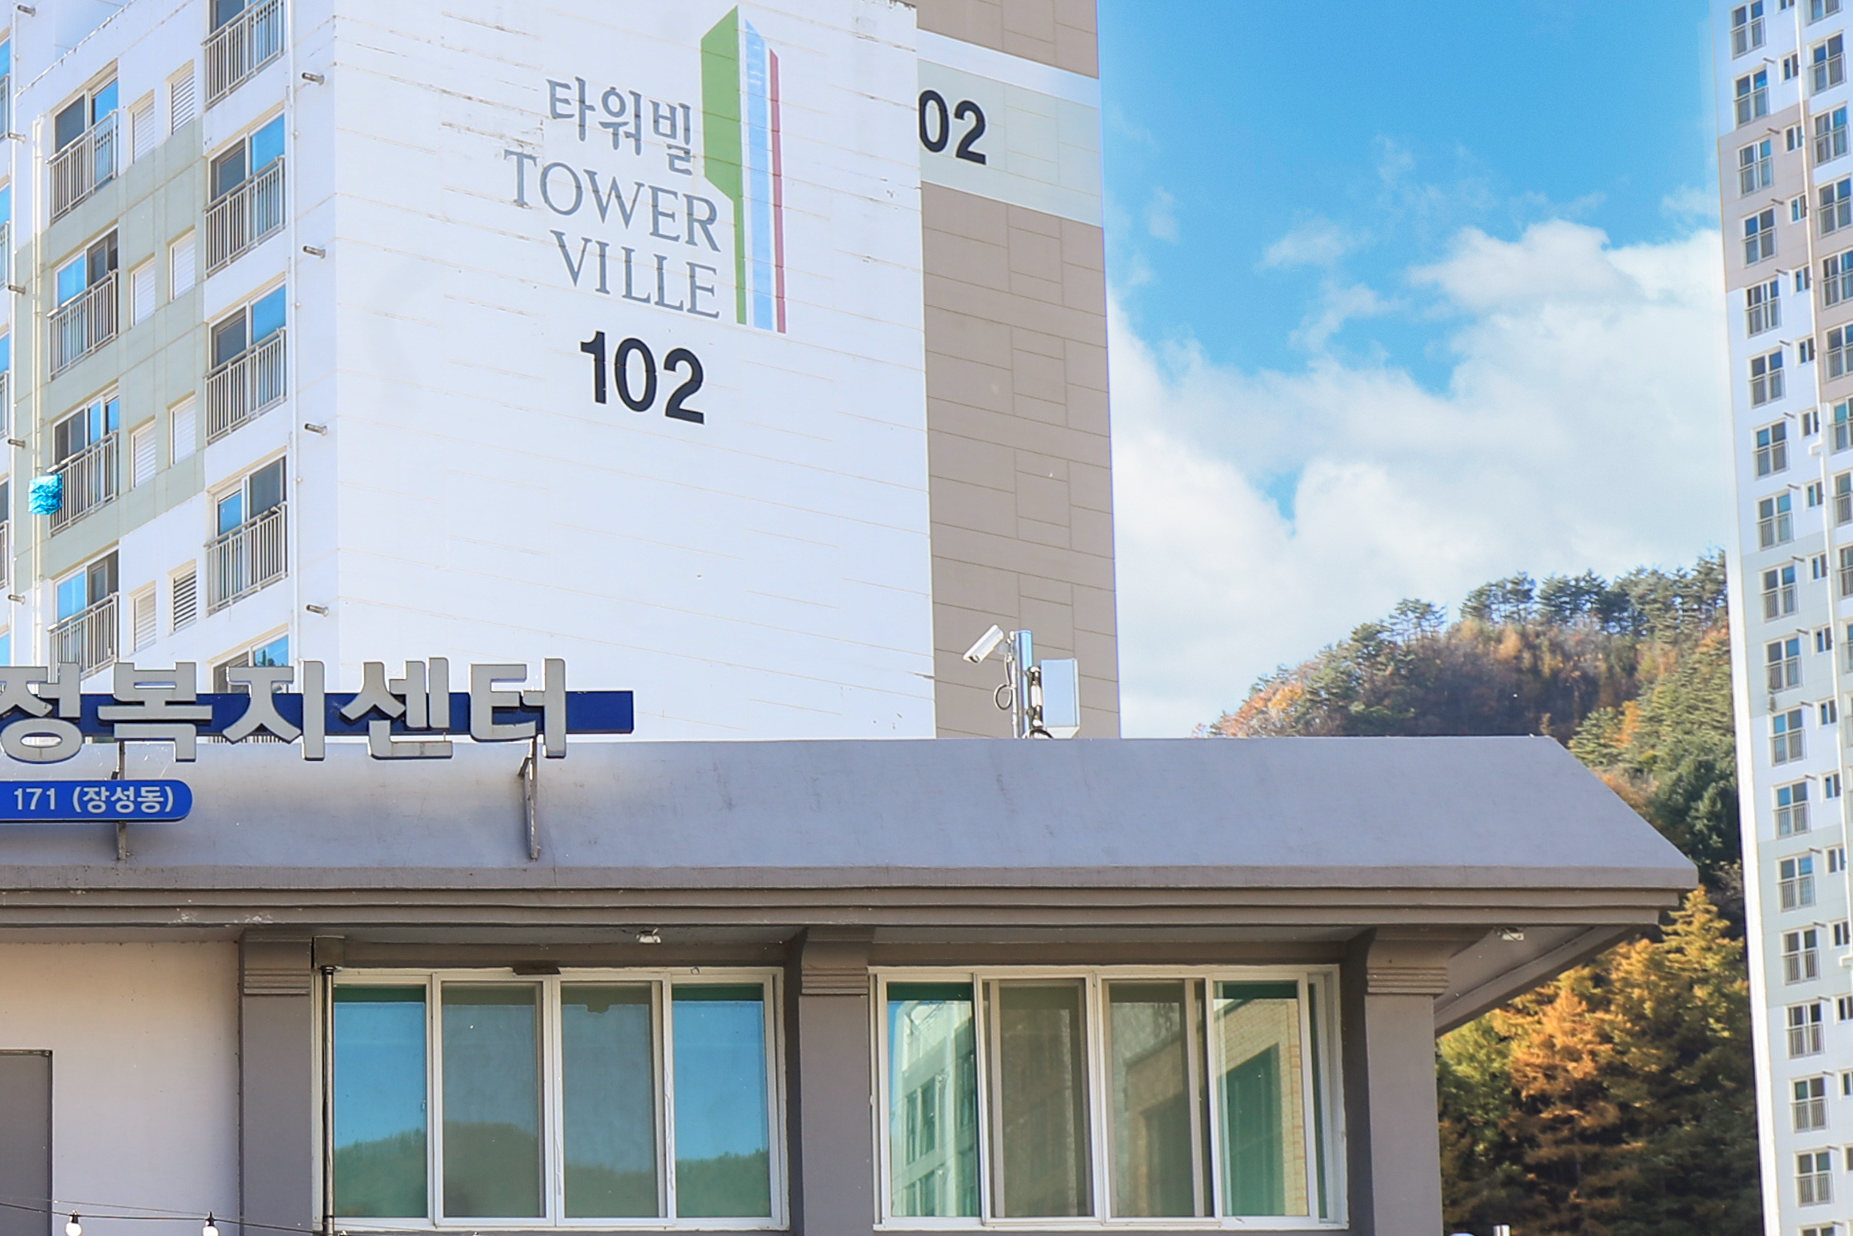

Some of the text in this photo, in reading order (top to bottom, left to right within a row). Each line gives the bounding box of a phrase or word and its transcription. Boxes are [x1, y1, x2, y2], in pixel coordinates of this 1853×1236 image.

[546, 76, 693, 175] 타워빌
[503, 149, 721, 253] TOWER
[549, 228, 721, 320] VILLE
[580, 330, 706, 426] 102
[13, 788, 57, 811] 171
[72, 786, 174, 814] (장성동)
